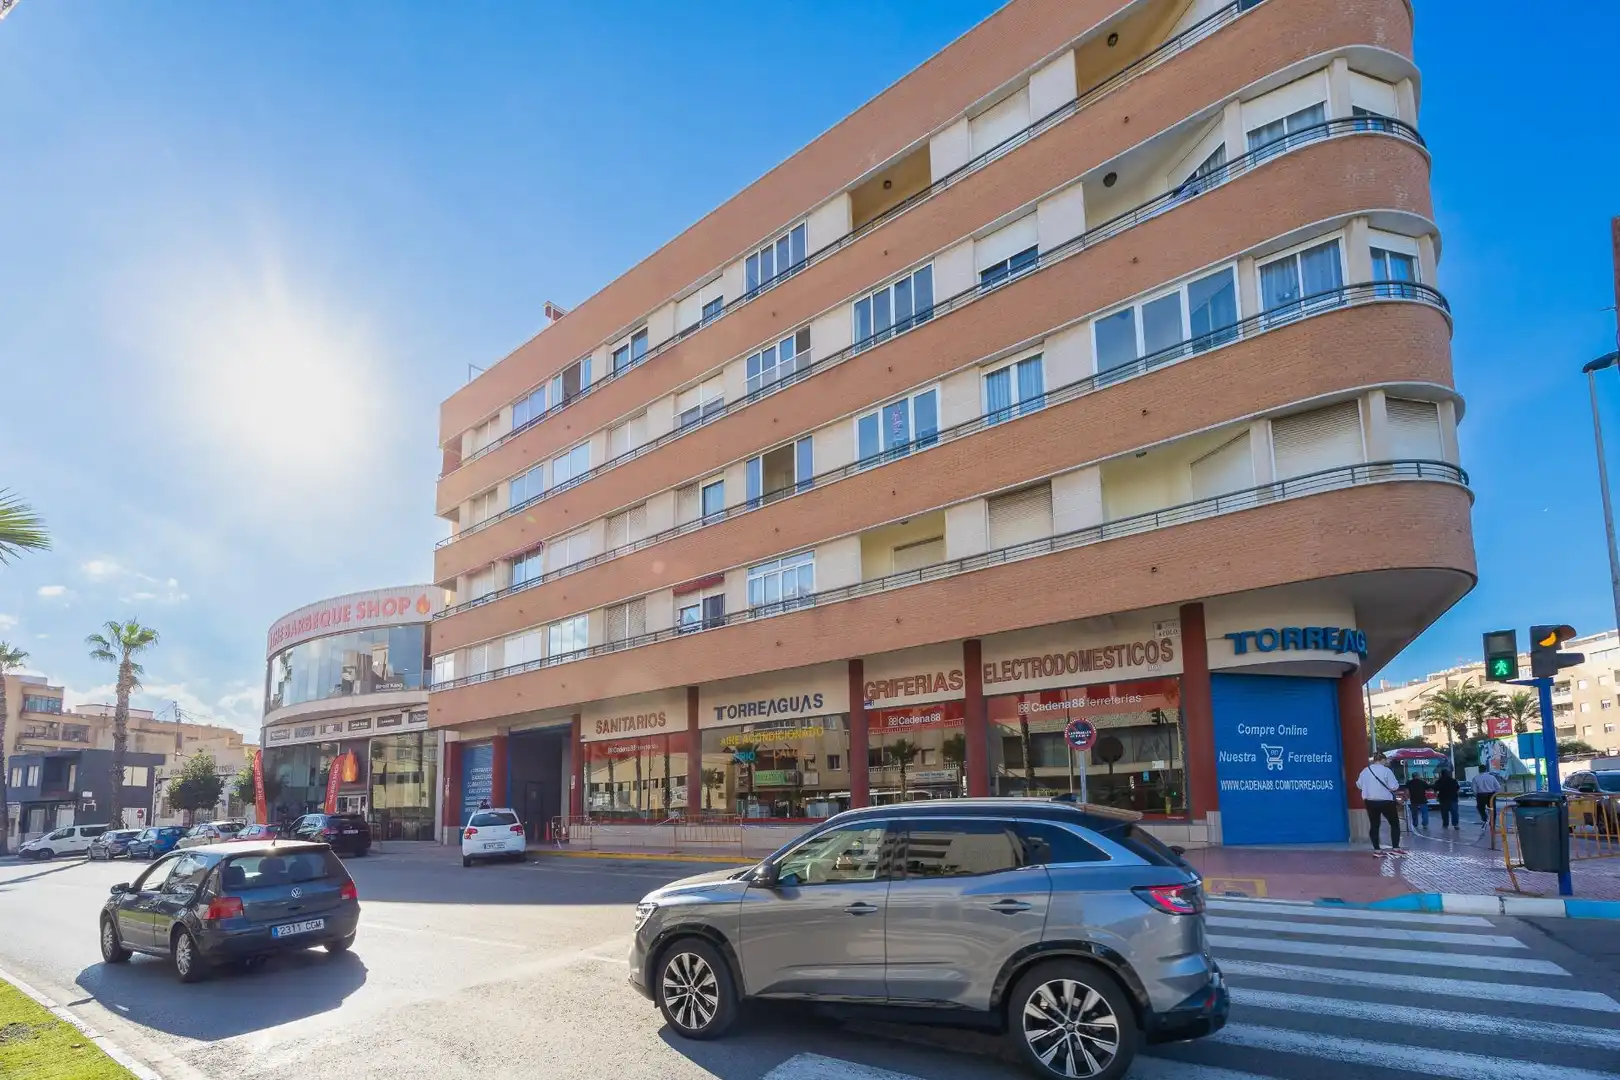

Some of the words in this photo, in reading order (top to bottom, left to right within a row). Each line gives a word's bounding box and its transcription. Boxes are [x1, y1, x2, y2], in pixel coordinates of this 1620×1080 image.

[356, 596, 411, 621] SHOP
[983, 637, 1174, 684] ELECTRODOMESTICOS
[864, 669, 964, 700] GRIFERIAS
[714, 693, 824, 721] TORREAGUAS
[1031, 697, 1086, 712] Cadena88
[595, 711, 667, 735] SANITARIOS
[898, 712, 941, 725] Cadena88
[1237, 723, 1275, 737] Compre
[1277, 724, 1308, 736] Online
[1219, 750, 1257, 762] Nuestra
[280, 923, 302, 935] 2311
